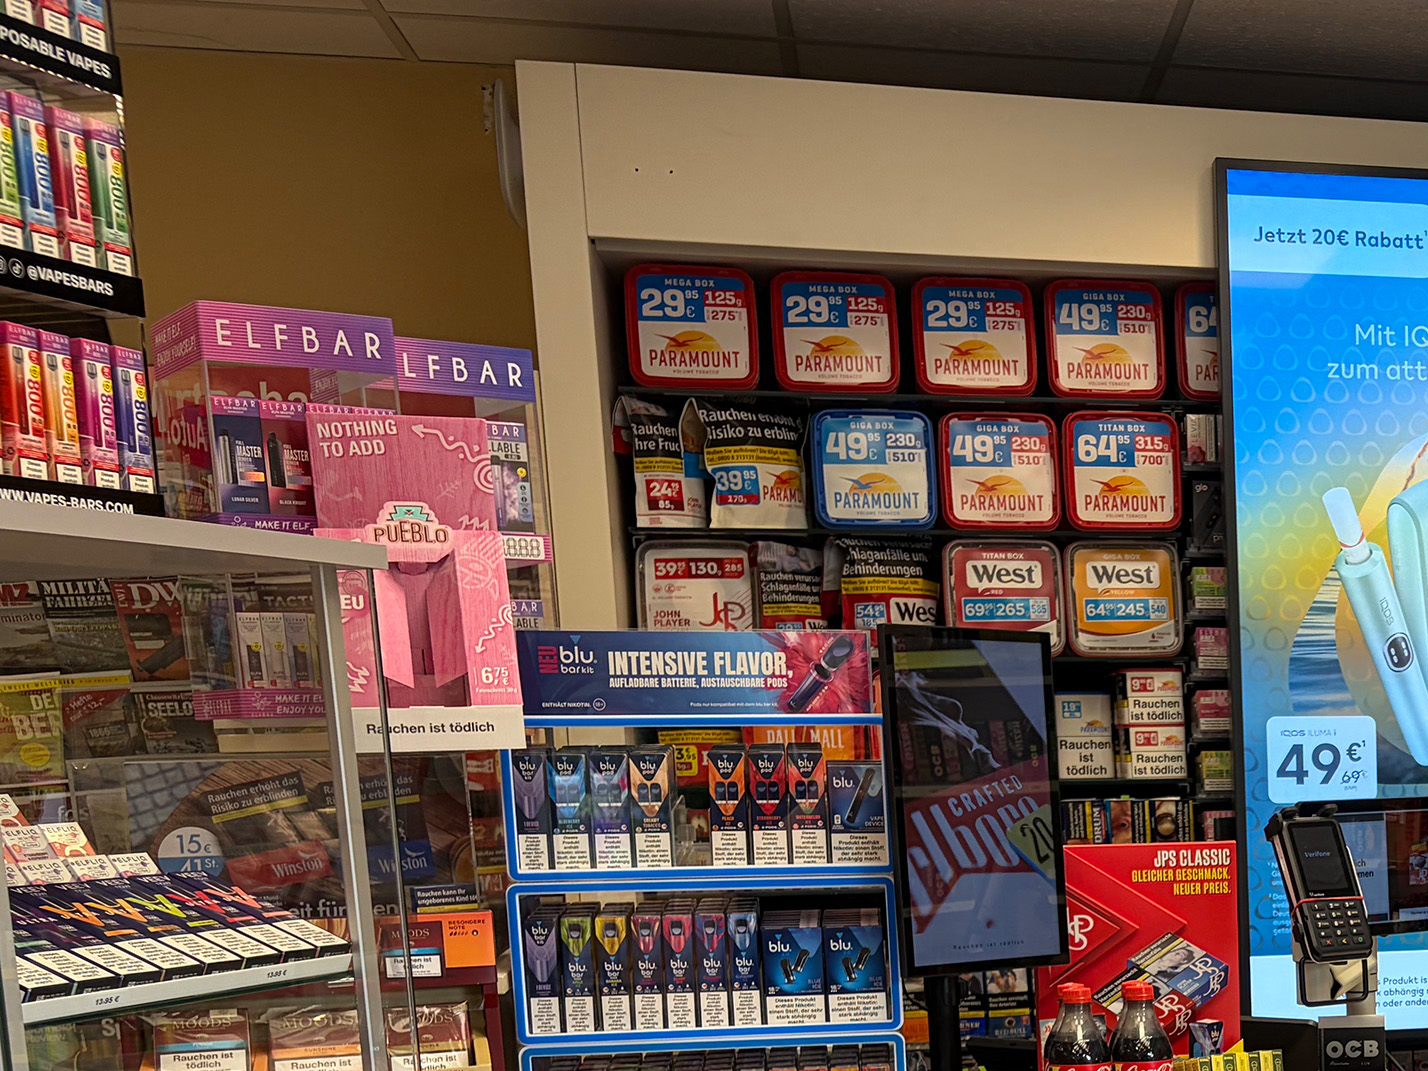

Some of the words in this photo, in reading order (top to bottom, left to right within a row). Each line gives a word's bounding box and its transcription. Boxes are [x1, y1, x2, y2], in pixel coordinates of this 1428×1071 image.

[67, 50, 111, 79] VAPES
[1253, 226, 1307, 245] Jetzt
[1312, 228, 1349, 246] 20€
[27, 265, 114, 296] @VAPESBARS
[664, 278, 692, 287] MEGA
[695, 279, 714, 287] BOX
[215, 318, 382, 359] ELFBAR
[1355, 323, 1396, 348] Mit
[649, 350, 740, 369] PARAMOUNT
[795, 355, 882, 373] PARAMOUNT
[1327, 362, 1378, 379] zum
[316, 420, 398, 438] NOTHING
[850, 422, 874, 430] GIGA
[876, 422, 894, 430] BOX
[1098, 424, 1122, 432] TITAN
[1126, 424, 1145, 432] BOX
[320, 441, 345, 458] TO
[349, 440, 385, 456] ADD
[834, 492, 919, 509] PARAMOUNT
[1085, 495, 1166, 512] PARAMOUNT
[373, 521, 449, 543] PUEBLO
[842, 563, 923, 577] Behinderungen
[972, 565, 1037, 584] West
[653, 610, 681, 619] JOHN
[654, 617, 691, 627] PLAYER
[608, 651, 708, 675] INTENSIVE
[715, 651, 793, 679] FLAVOR,
[609, 678, 660, 688] AUFLADBARE
[661, 678, 699, 689] BATTERIE,
[701, 678, 765, 688] AUSTAUSCHBARE
[766, 678, 788, 688] PODS
[366, 722, 425, 735] Rauchen
[429, 722, 446, 733] ist
[449, 722, 495, 733] tödlich
[1059, 740, 1111, 750] Rauchen
[1079, 753, 1094, 763] ist
[1066, 765, 1107, 776] tödlich
[1153, 849, 1177, 867] JPS
[1180, 849, 1231, 866] CLASSIC
[271, 858, 323, 878] Winston
[1132, 868, 1174, 883] GLEICHER
[1176, 868, 1231, 881] GESCHMACK.
[1173, 883, 1202, 896] NEUER
[1203, 881, 1231, 895] PREIS.
[1383, 973, 1418, 986] Produkt
[1382, 985, 1420, 999] abhängig
[1382, 996, 1404, 1008] oder
[1326, 1039, 1379, 1059] OCB
